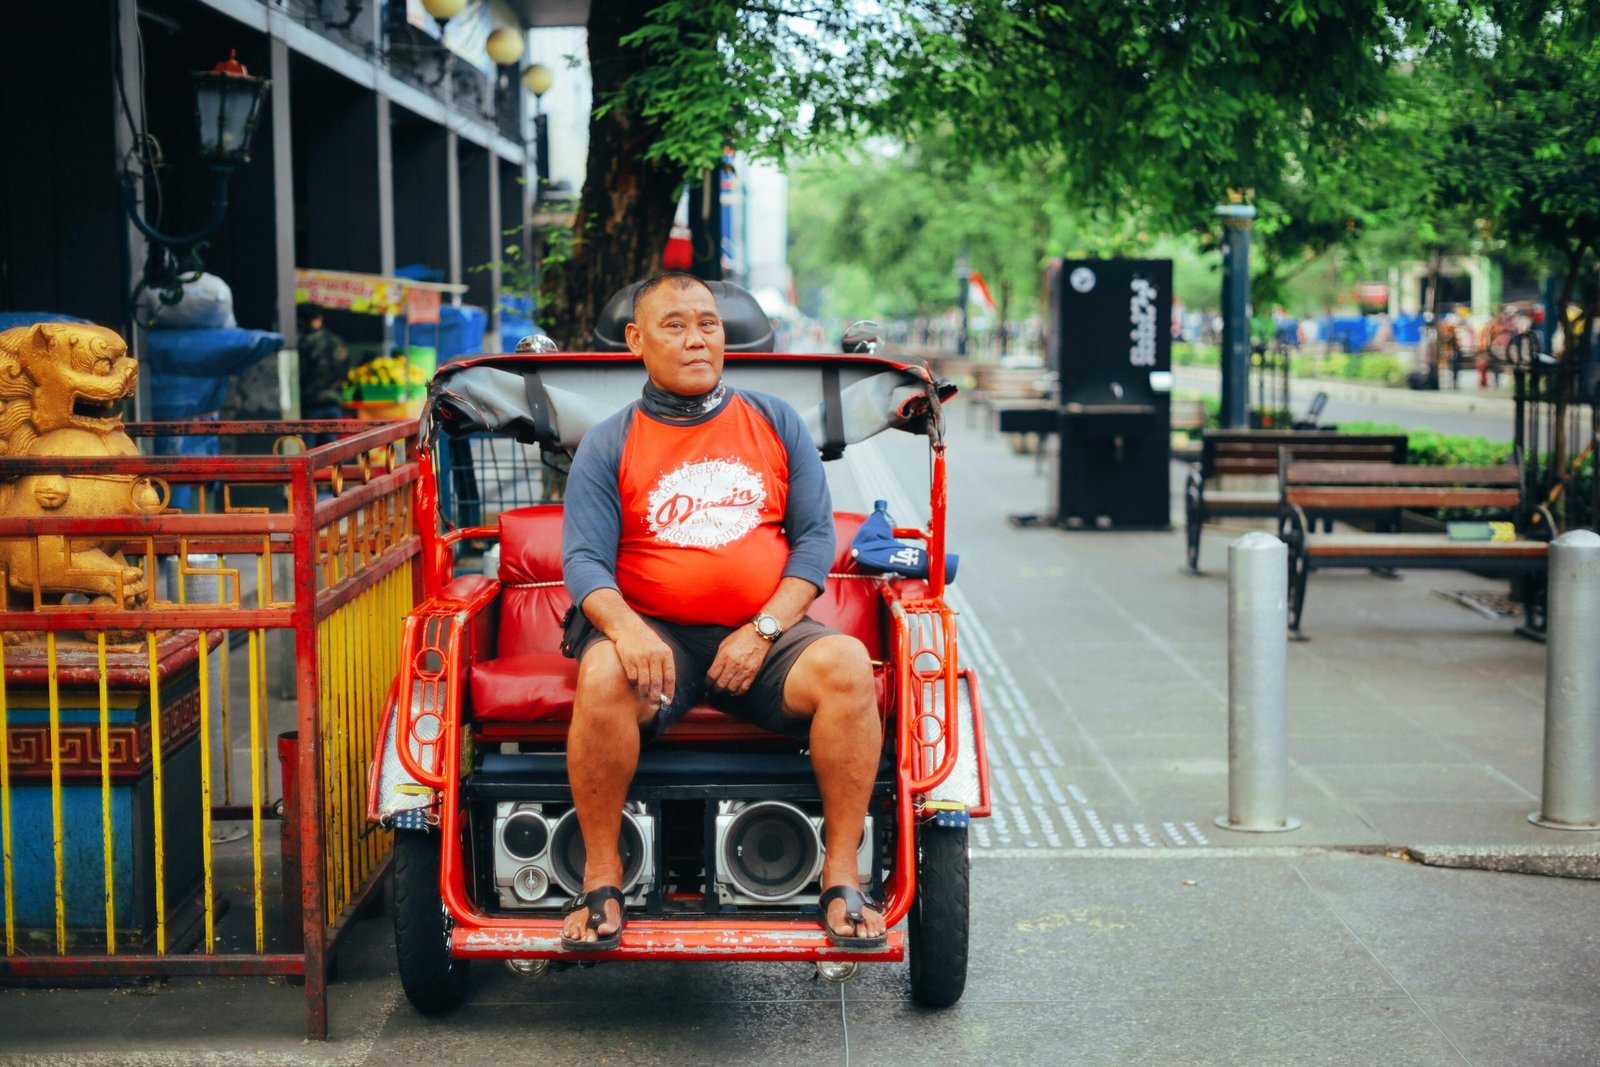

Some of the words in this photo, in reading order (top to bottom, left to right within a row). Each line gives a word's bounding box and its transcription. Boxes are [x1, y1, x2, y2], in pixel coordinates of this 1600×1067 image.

[656, 477, 678, 499] THE
[679, 463, 731, 479] LEGEND
[889, 547, 919, 567] LA
